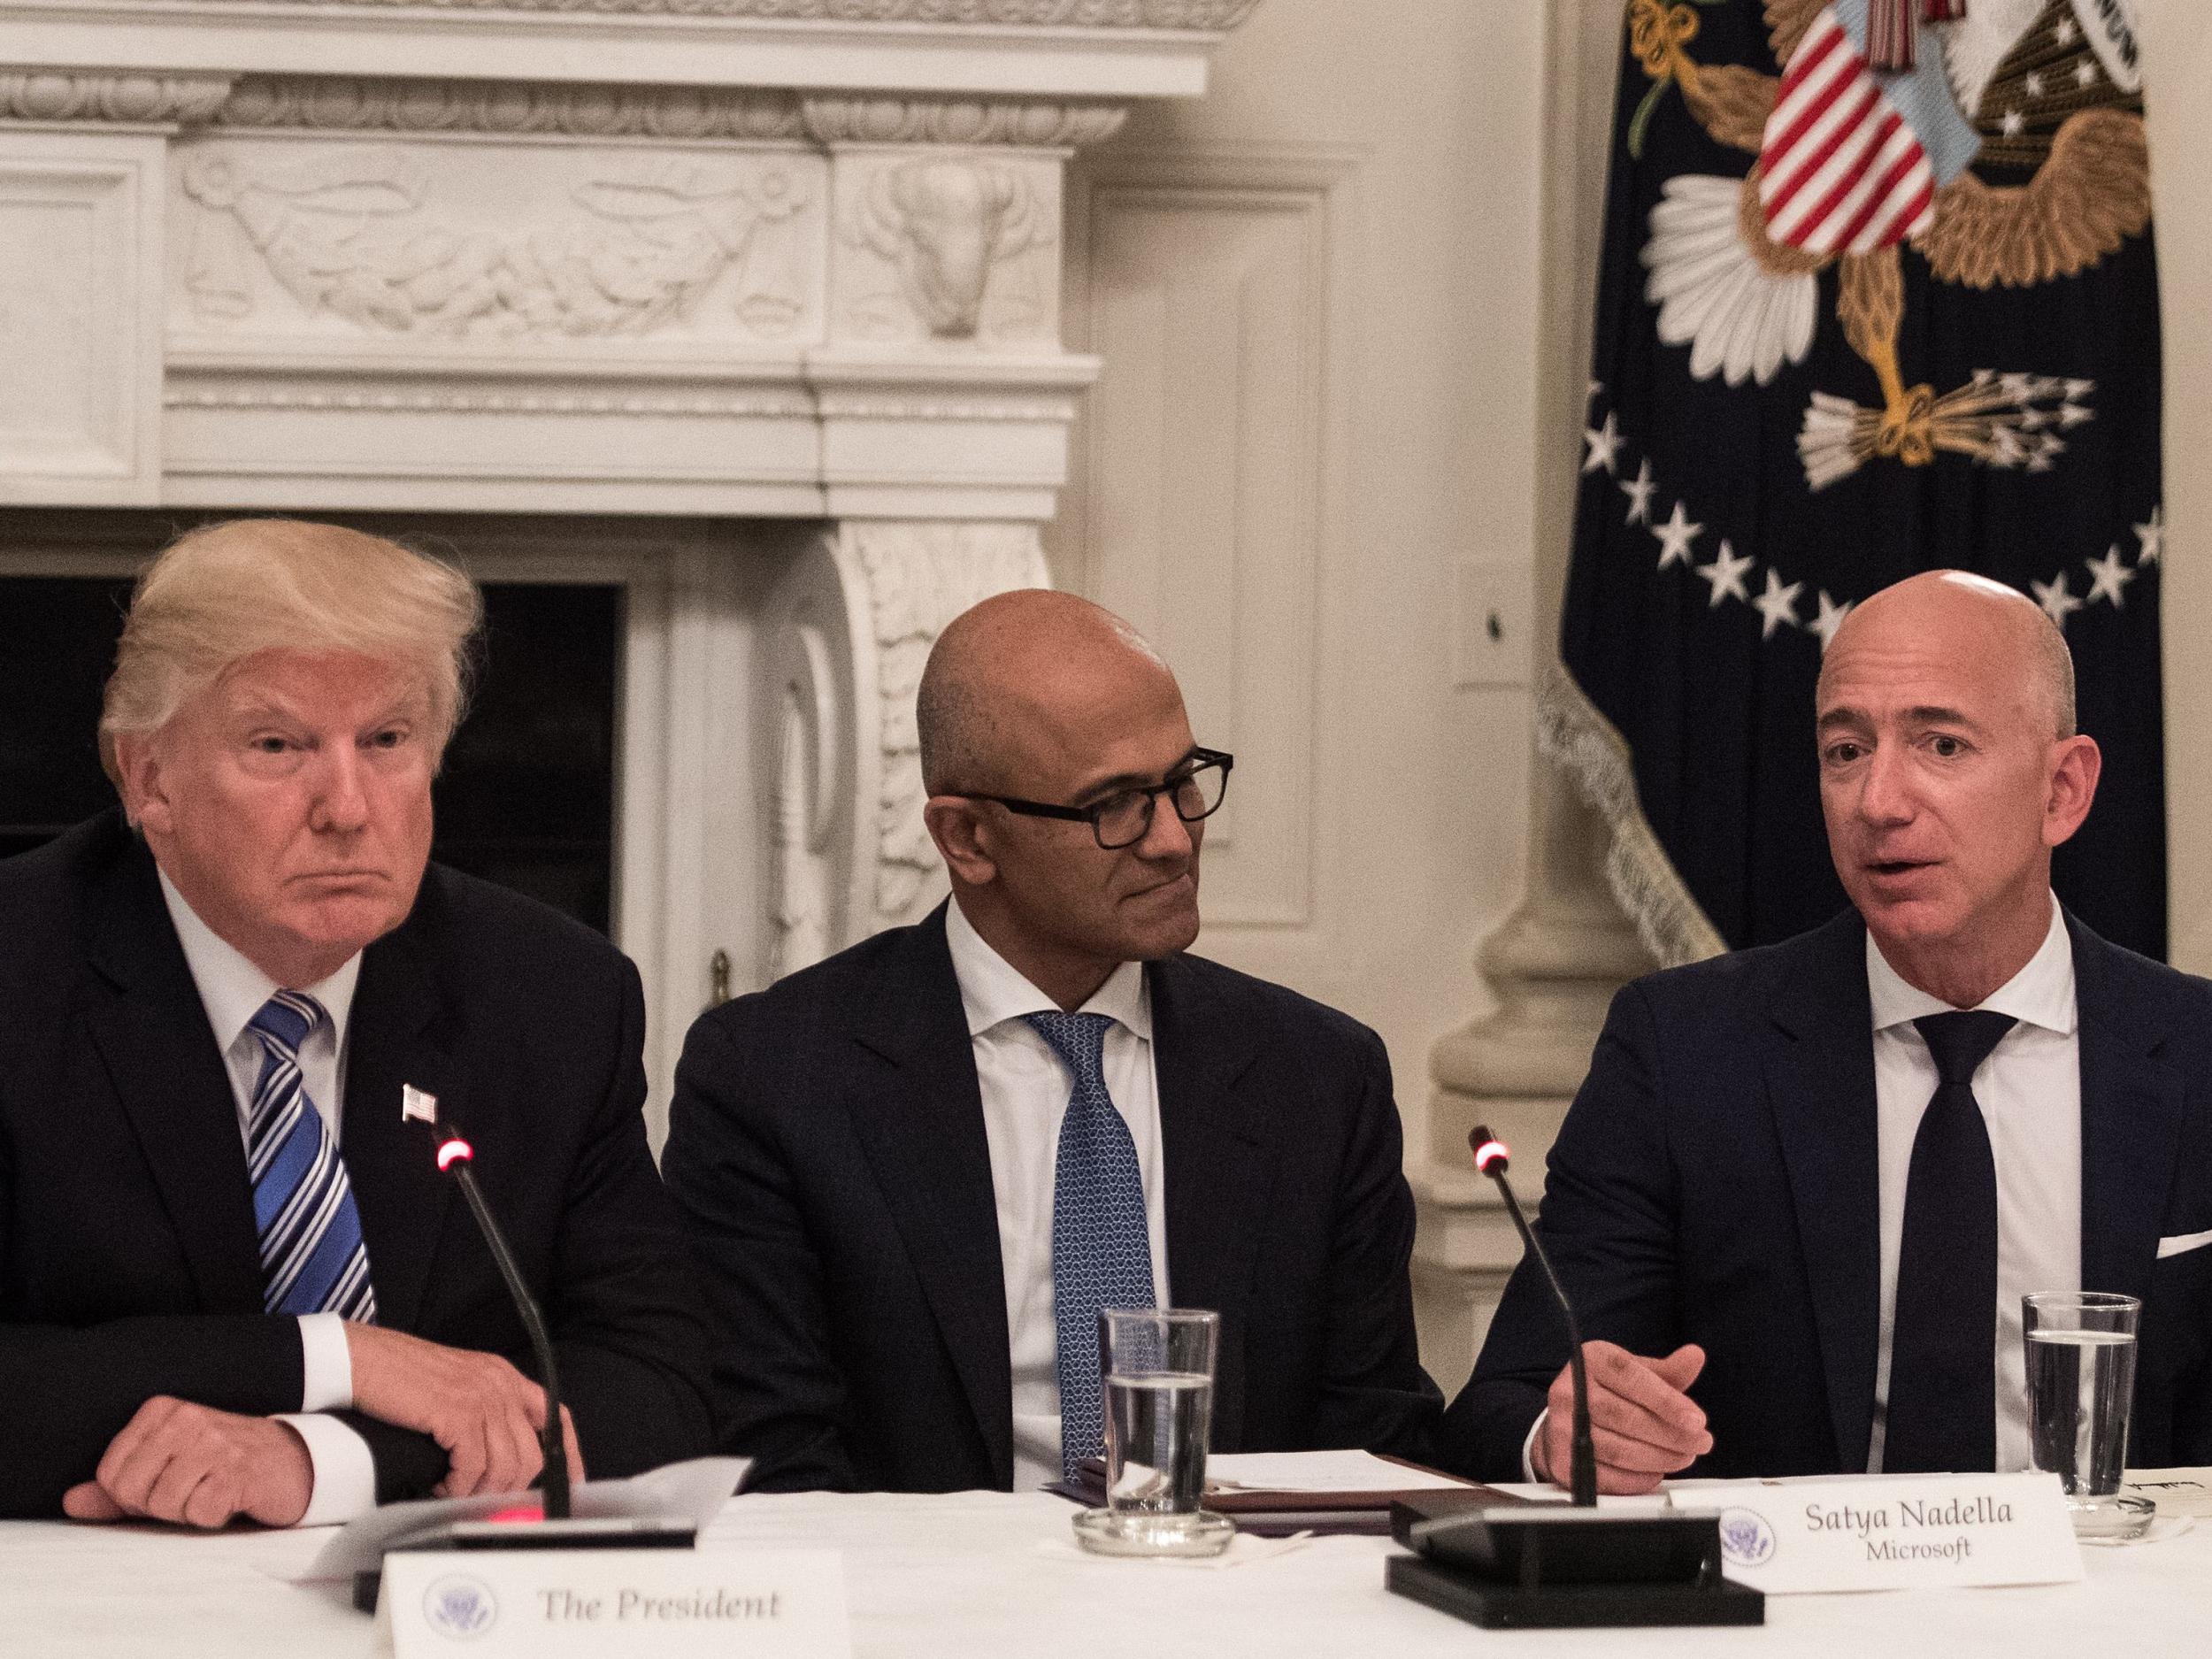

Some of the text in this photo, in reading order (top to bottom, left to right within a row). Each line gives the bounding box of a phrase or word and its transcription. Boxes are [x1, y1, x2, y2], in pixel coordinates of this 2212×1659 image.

[1806, 1496, 2013, 1539] Satya Nadella
[1866, 1536, 1971, 1564] Microsoft
[537, 1588, 780, 1620] The President
